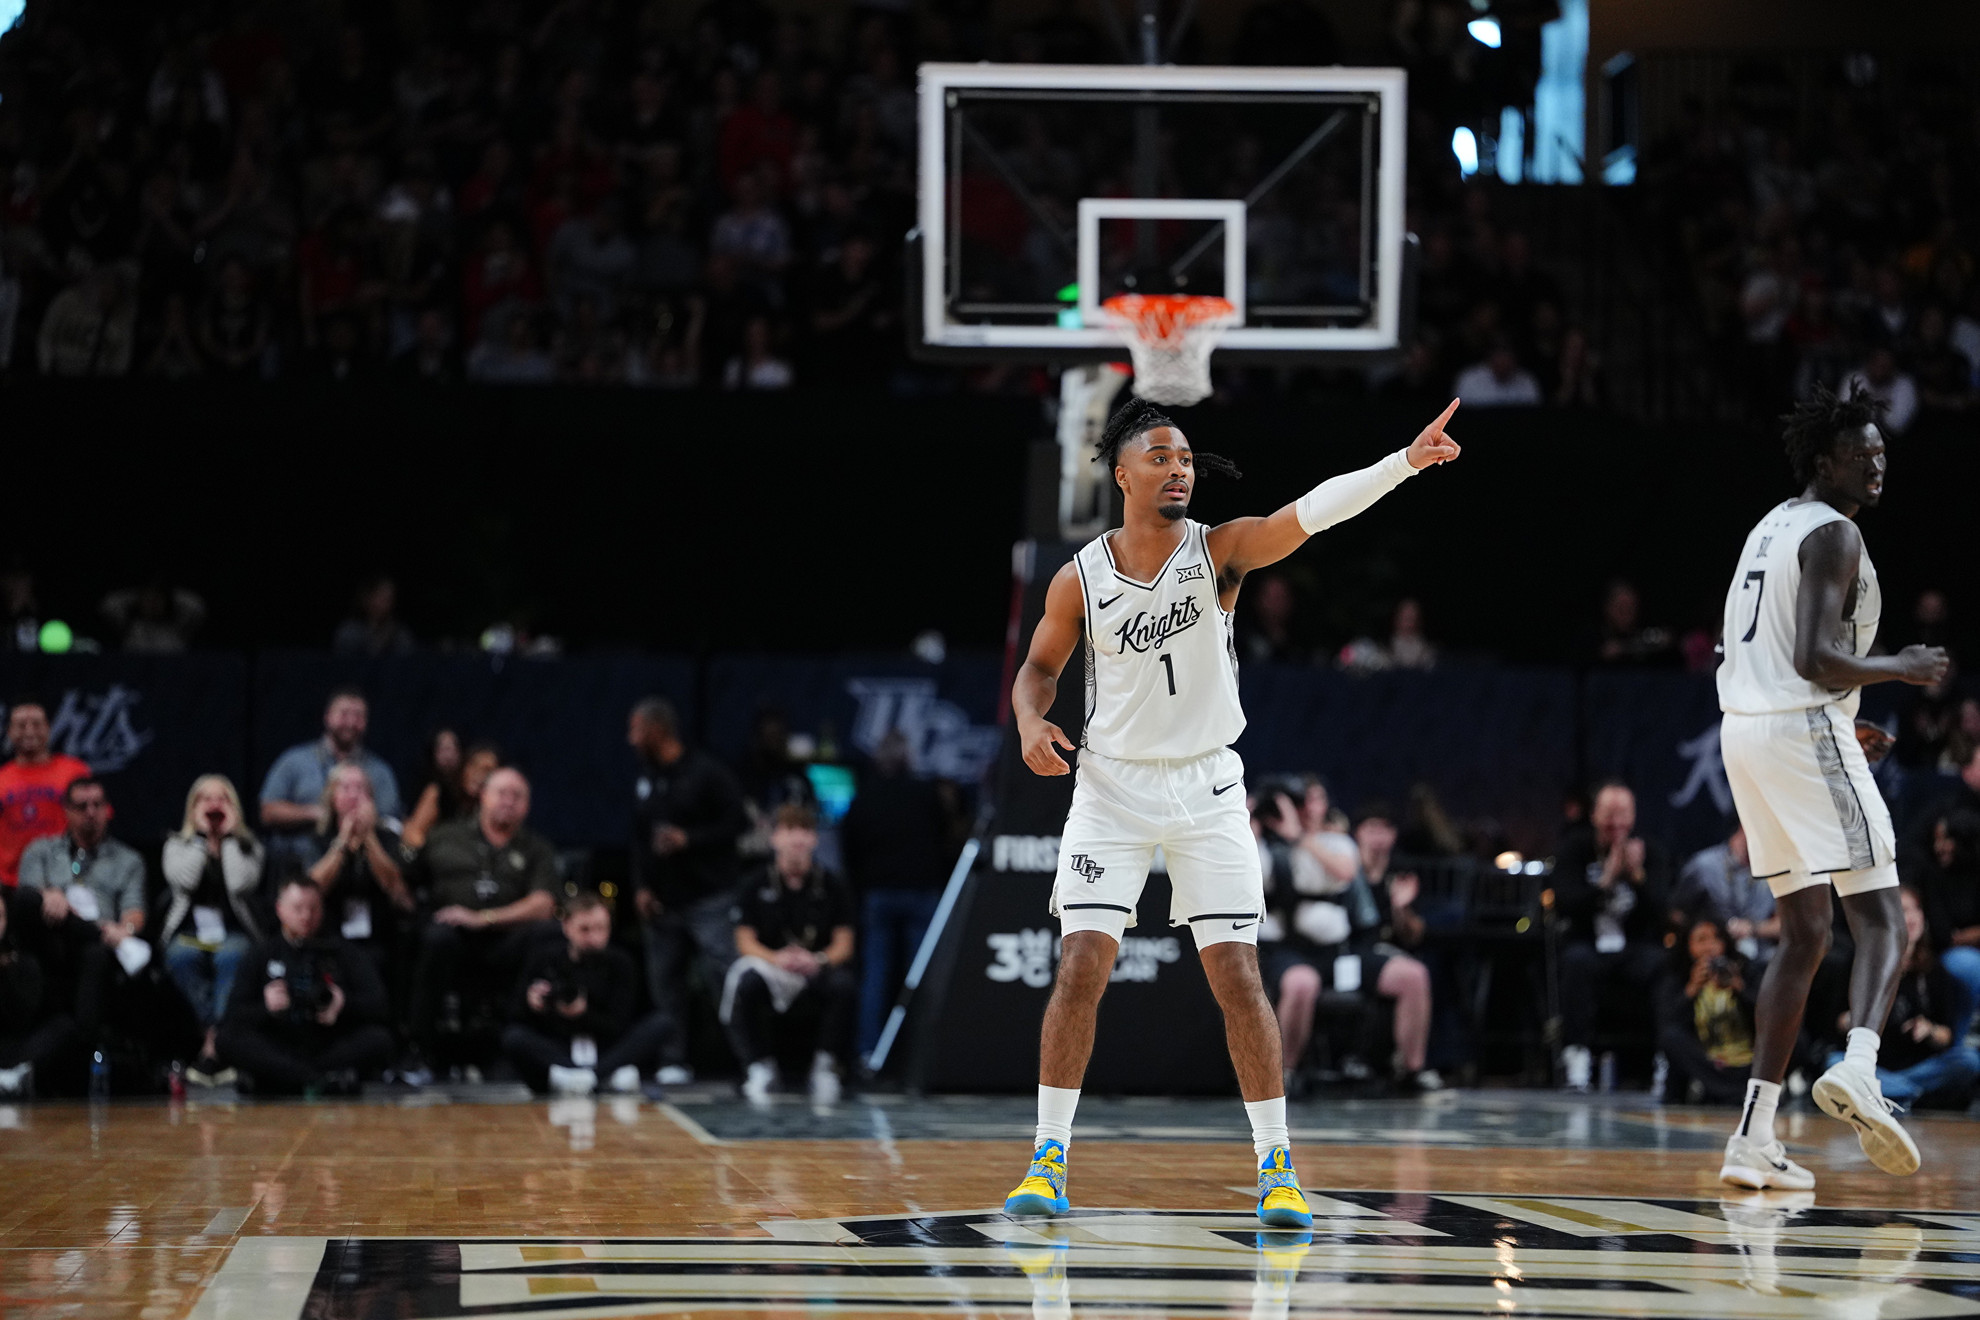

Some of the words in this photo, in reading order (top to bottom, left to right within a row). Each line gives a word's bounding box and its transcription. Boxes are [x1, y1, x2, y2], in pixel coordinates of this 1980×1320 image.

[1115, 595, 1203, 655] Knights
[1741, 570, 1766, 643] 7
[1159, 653, 1177, 696] 1
[993, 835, 1062, 872] FIRS
[1071, 854, 1105, 884] UCF
